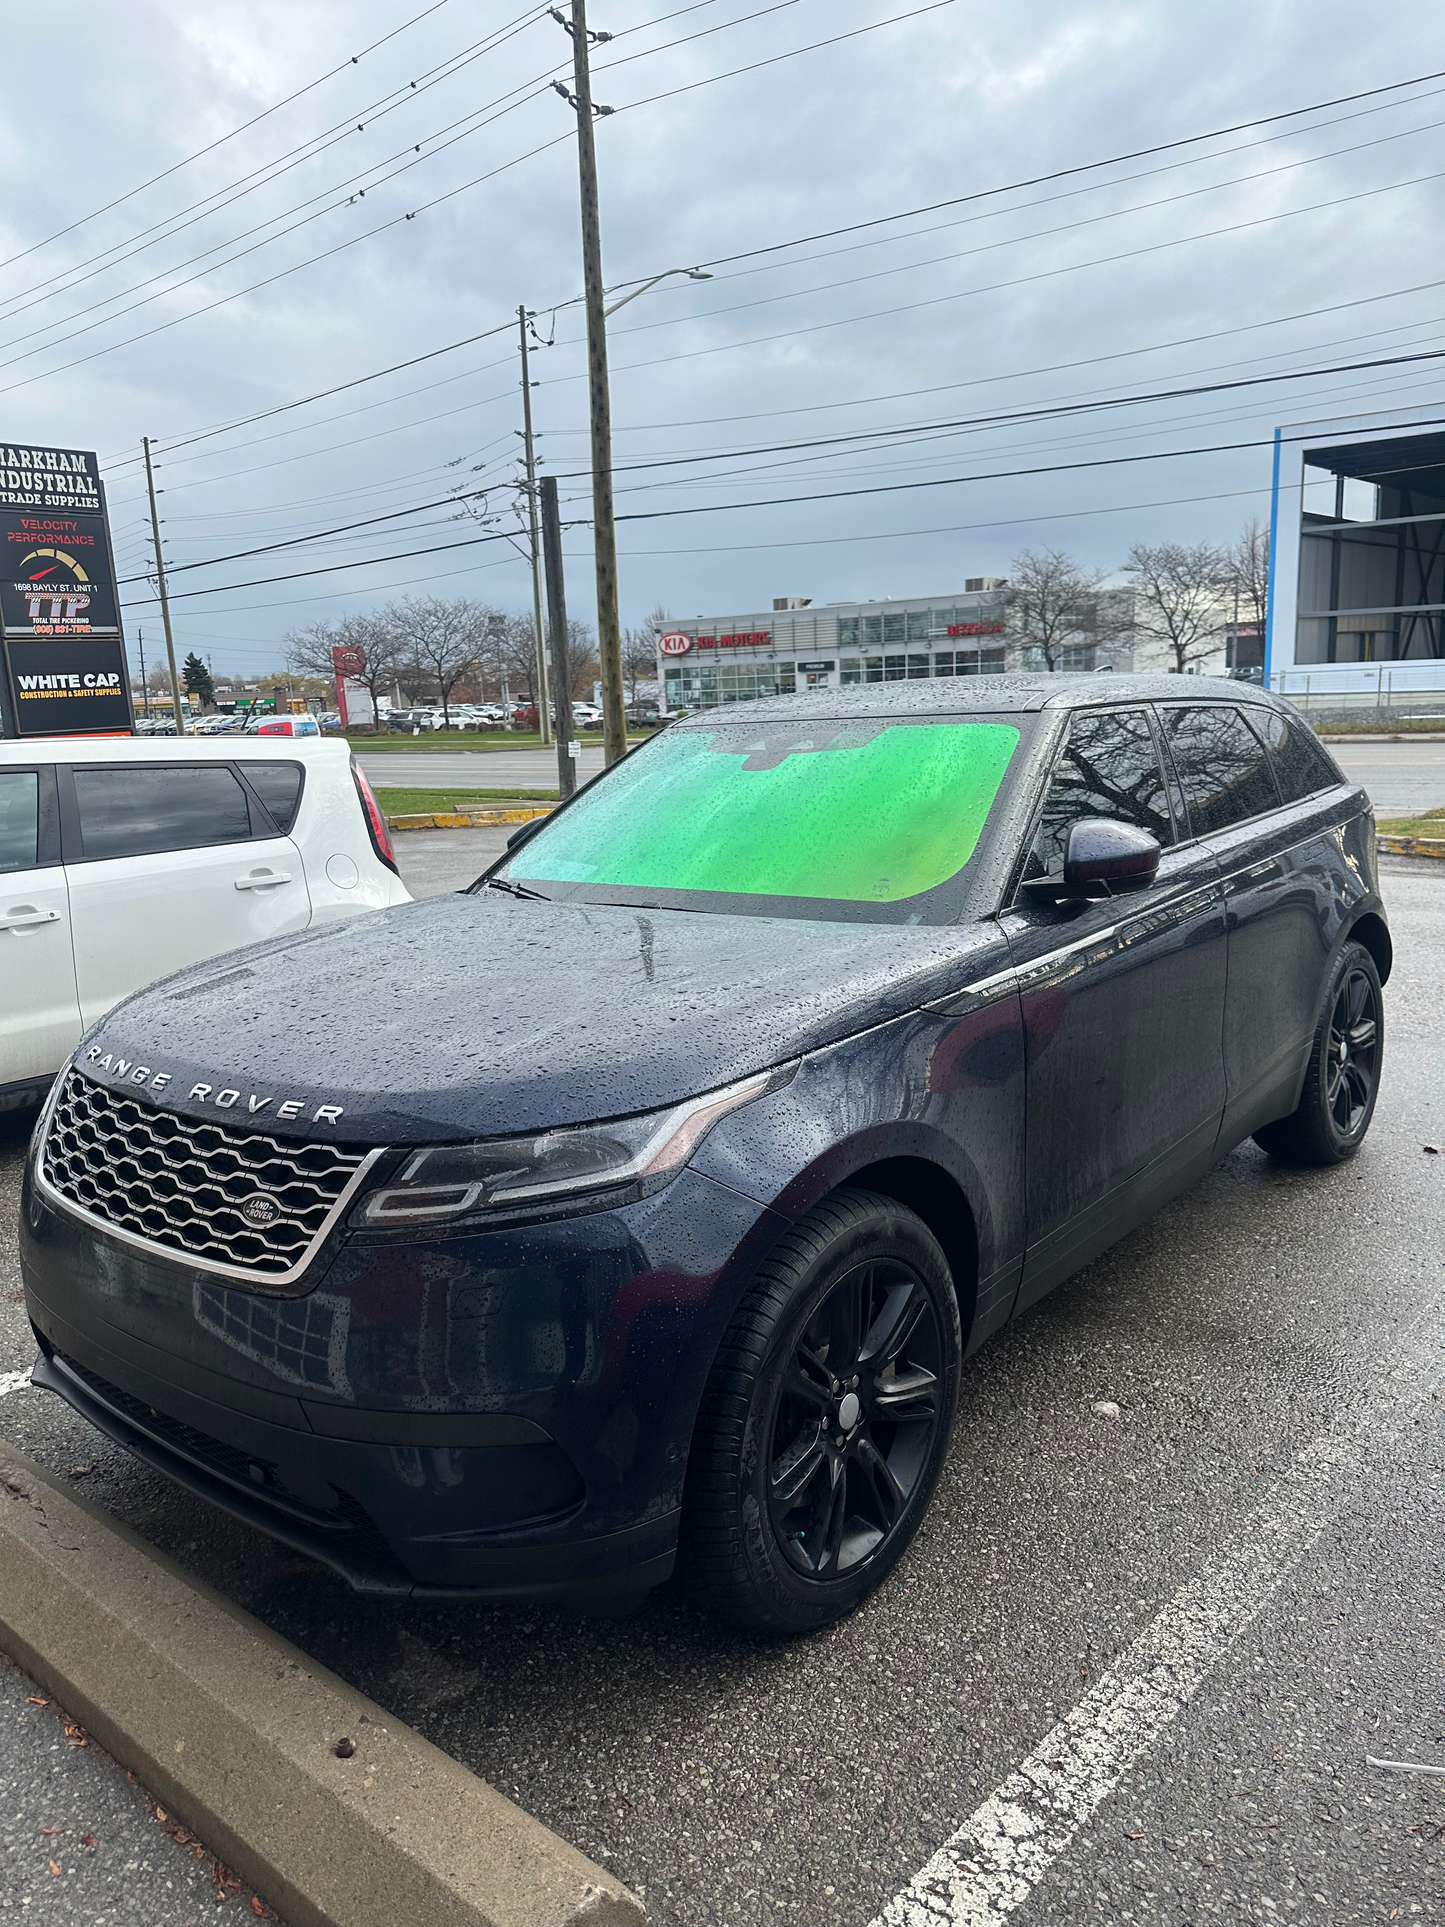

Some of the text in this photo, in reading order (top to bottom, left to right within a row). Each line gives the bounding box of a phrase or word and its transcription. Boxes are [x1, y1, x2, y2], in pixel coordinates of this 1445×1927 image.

[0, 492, 99, 508] TRADE SUPPLIES
[21, 519, 77, 531] VELOCITY
[7, 532, 95, 545] PERFORMANCE
[14, 583, 32, 591] 1698
[32, 583, 58, 592] BAYLY
[73, 584, 92, 592] UNIT
[25, 592, 90, 617] TTP
[664, 637, 687, 651] KIA
[697, 632, 770, 648] KIA MOTORS
[18, 674, 80, 689] WHITE
[20, 689, 68, 699] CONSTRUCTION
[74, 689, 94, 697] SAFETY
[87, 1045, 344, 1125] RANGE ROVER
[250, 1200, 270, 1211] LAND
[249, 1208, 273, 1220] ROVER
